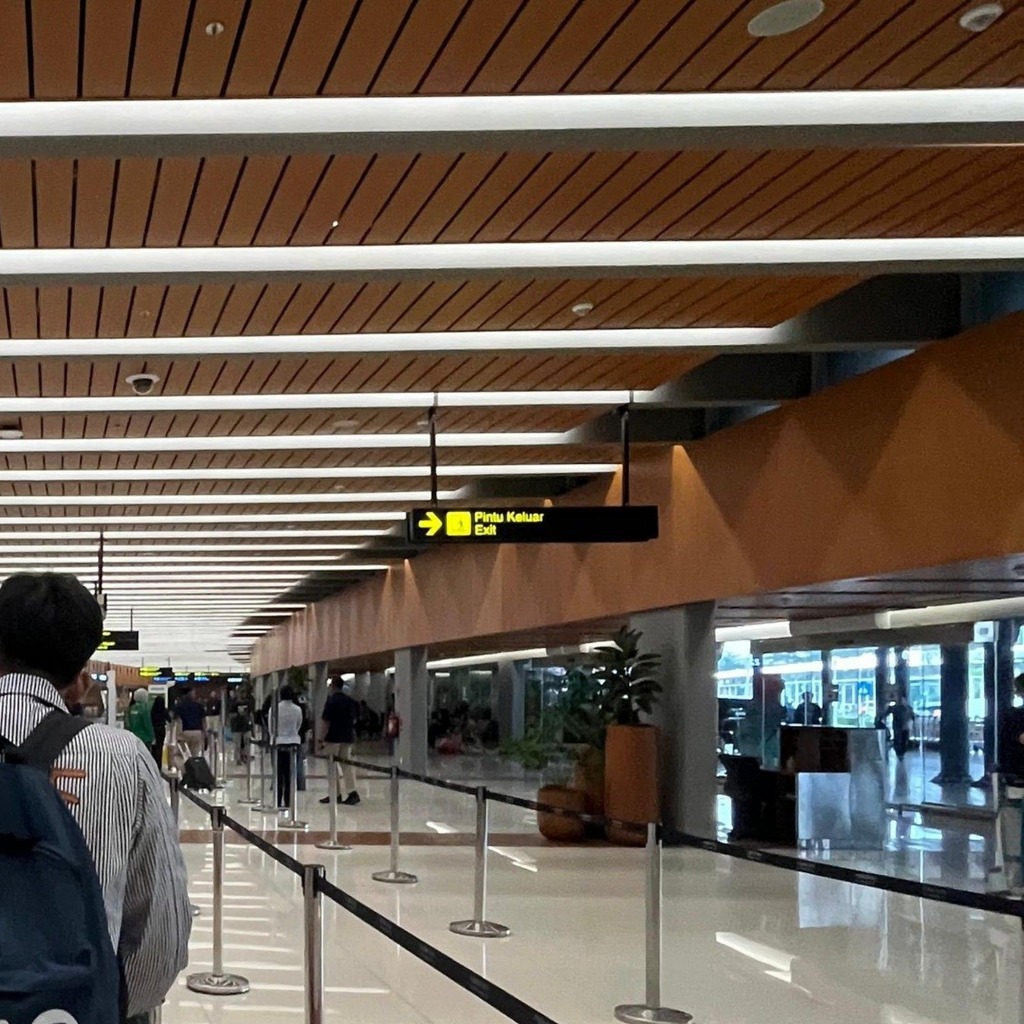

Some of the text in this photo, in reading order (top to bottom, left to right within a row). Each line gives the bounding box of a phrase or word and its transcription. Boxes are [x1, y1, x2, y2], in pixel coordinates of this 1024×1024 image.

[474, 511, 545, 523] Pintu Keluar
[474, 525, 497, 536] Exit
